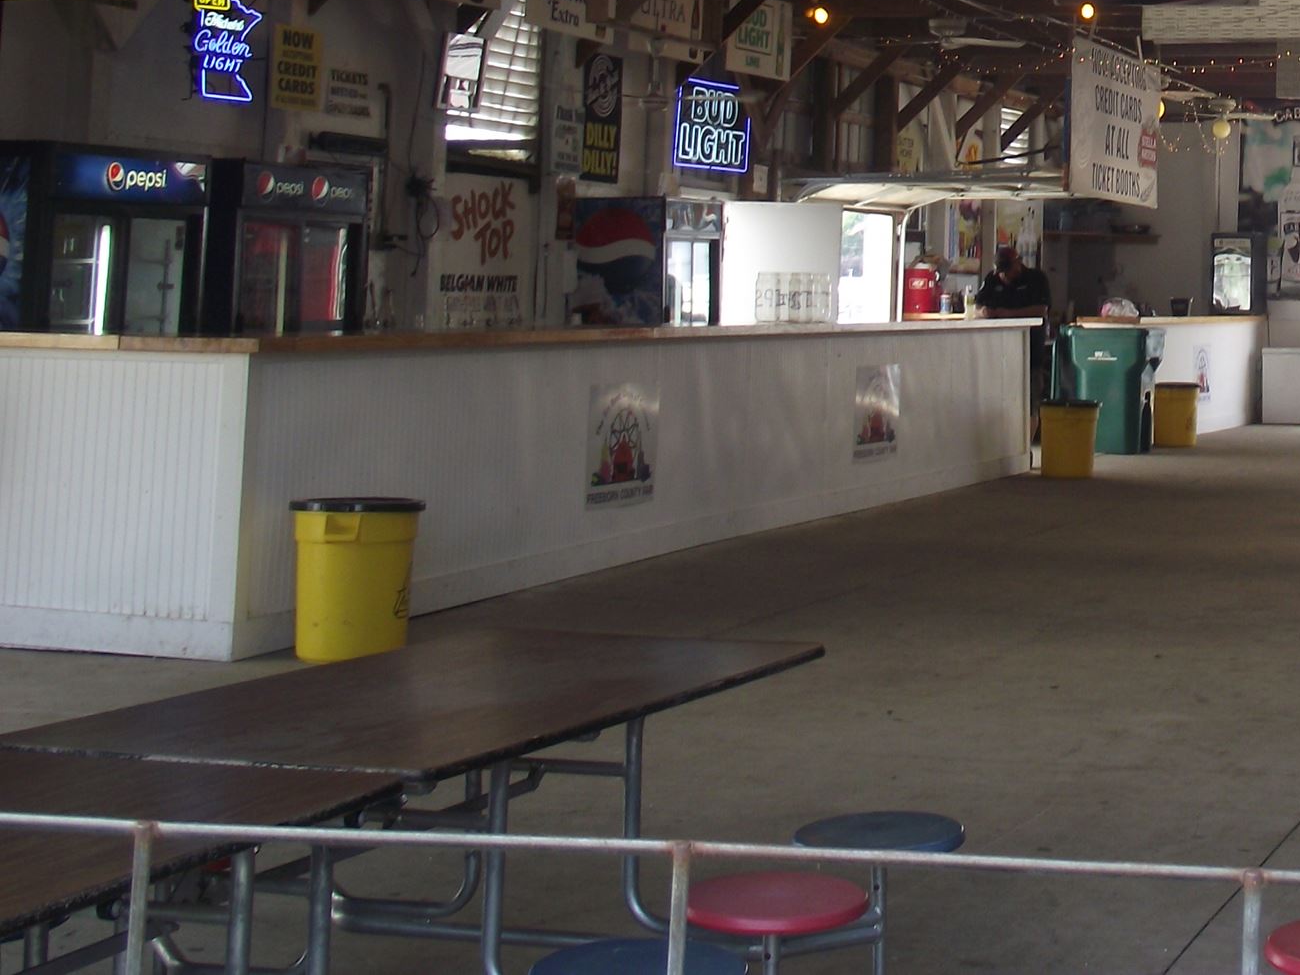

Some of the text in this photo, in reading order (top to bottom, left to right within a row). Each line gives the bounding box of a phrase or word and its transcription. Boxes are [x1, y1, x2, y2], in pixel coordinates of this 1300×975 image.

[547, 0, 580, 26] Extra
[193, 28, 253, 58] Golden
[282, 29, 315, 50] NOW
[736, 25, 771, 50] LIGHT
[202, 54, 244, 73] LIGHT
[276, 60, 318, 79] CREDIT
[277, 77, 316, 95] CARDS
[330, 68, 368, 86] TICKETS
[691, 86, 740, 127] BUD
[1095, 84, 1143, 123] CREDIT CARDS
[585, 120, 618, 150] DILLY
[678, 122, 746, 166] LIGHT
[1104, 123, 1130, 160] AT ALL
[125, 168, 168, 192] pepsi
[275, 180, 304, 197] pepsi
[1092, 162, 1141, 198] TICKET BOOTHS
[451, 180, 516, 242] SHOCK
[473, 218, 515, 266] TOP
[440, 273, 518, 293] BELGIAN WHITE
